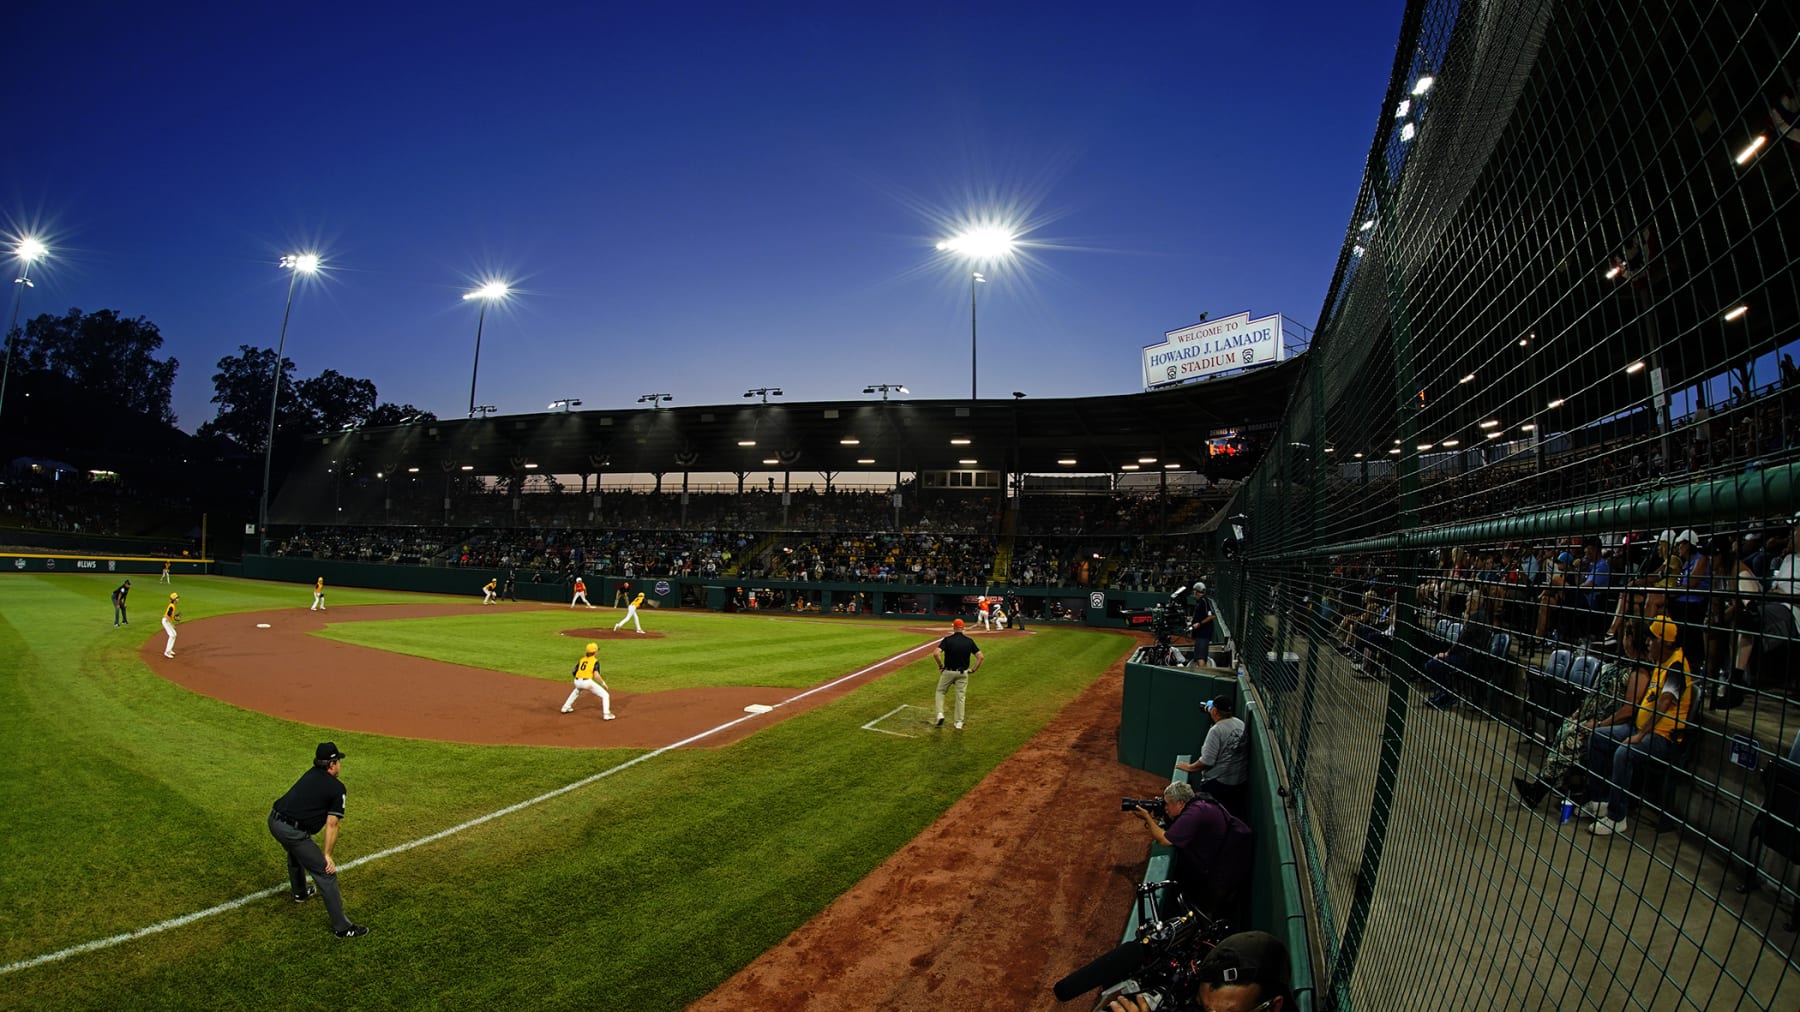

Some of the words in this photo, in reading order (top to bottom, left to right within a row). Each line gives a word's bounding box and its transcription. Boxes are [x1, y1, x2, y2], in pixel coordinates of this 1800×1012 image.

[1178, 326, 1222, 343] WELCOME
[1225, 322, 1238, 332] TO
[1150, 345, 1201, 367] HOWARD
[1204, 342, 1212, 354] J.
[1215, 328, 1272, 352] LAMADE
[1181, 352, 1236, 374] STADIUM
[580, 661, 588, 671] 6
